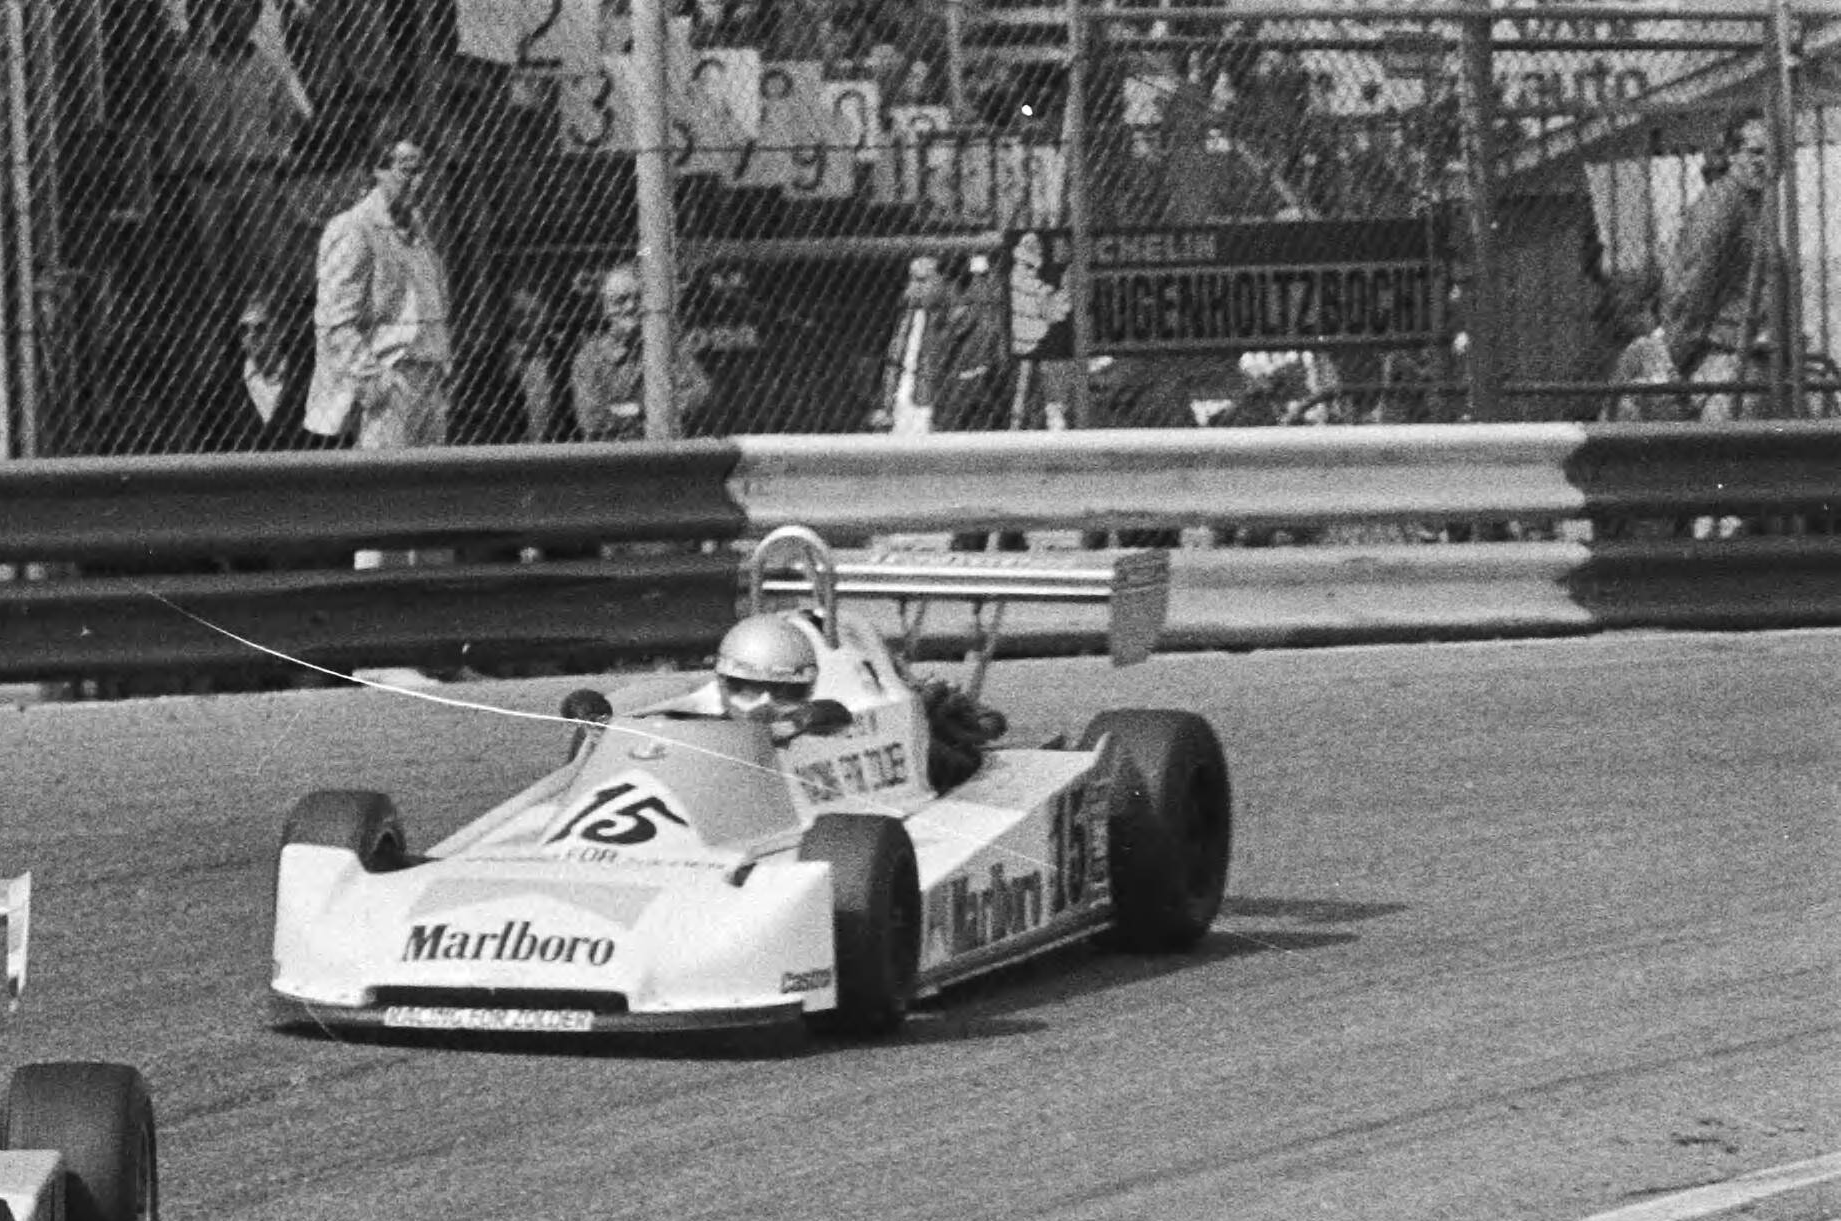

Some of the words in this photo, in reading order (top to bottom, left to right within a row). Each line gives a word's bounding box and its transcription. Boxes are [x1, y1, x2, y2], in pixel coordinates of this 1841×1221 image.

[1054, 232, 1217, 264] MCHELIN
[542, 782, 690, 845] 15
[401, 920, 616, 967] Marlboro
